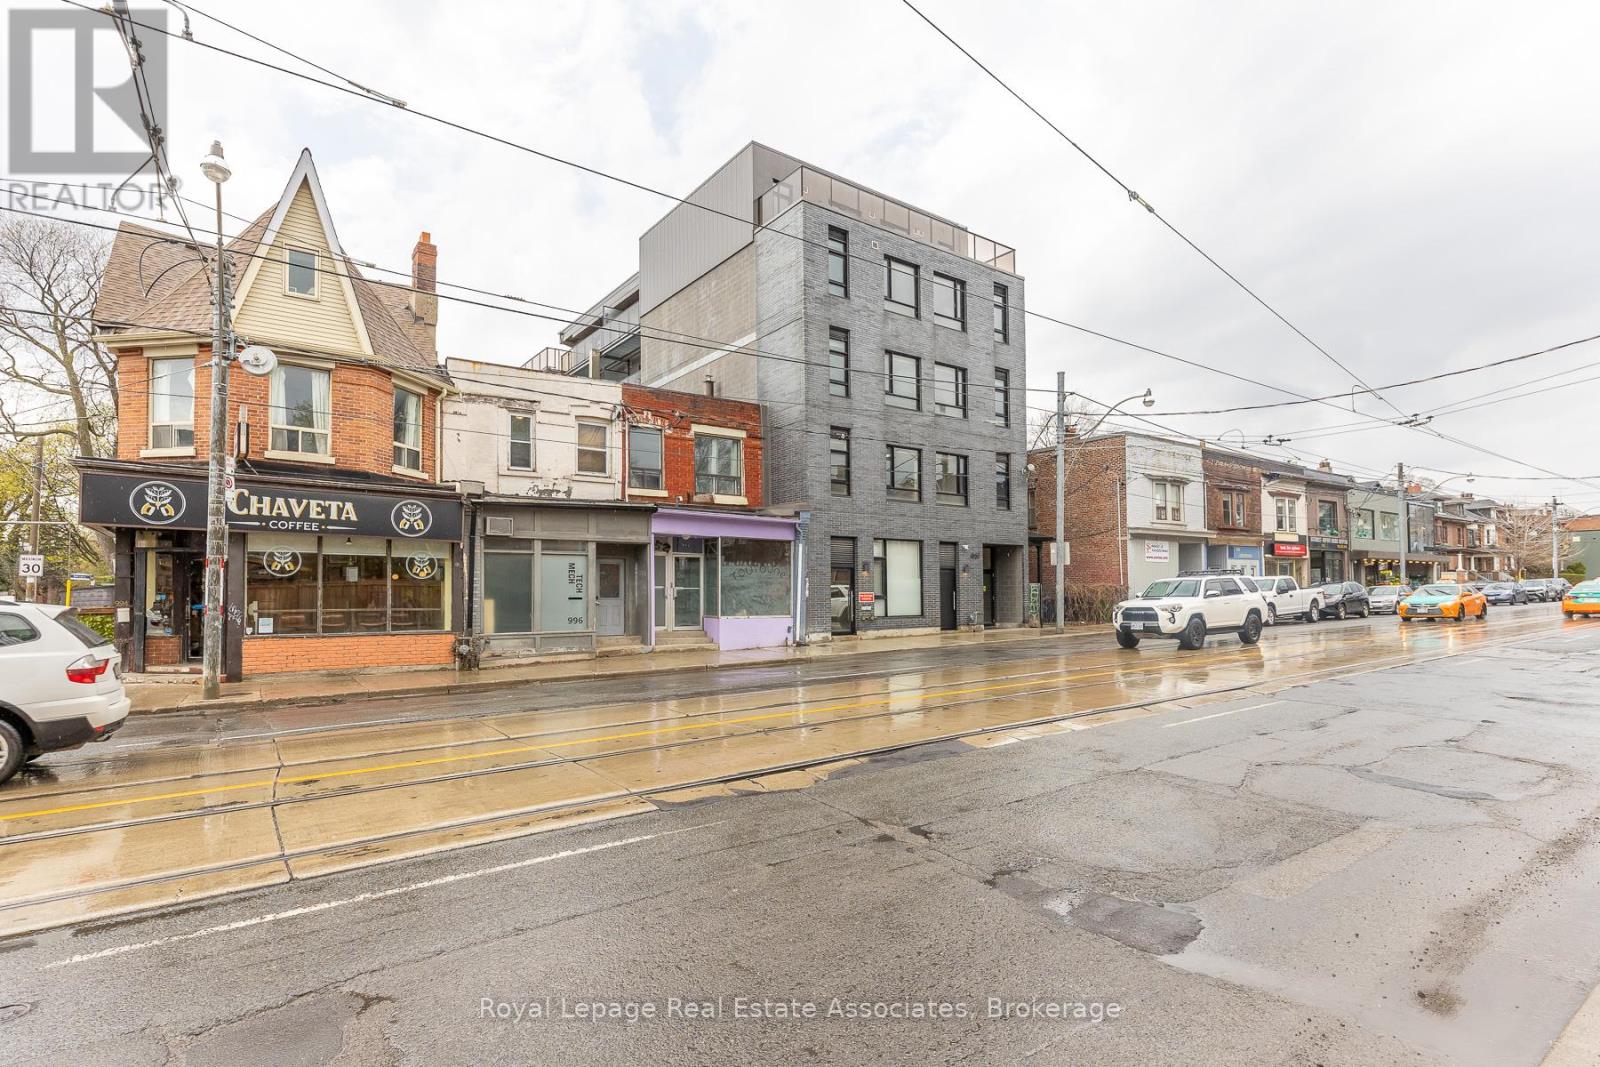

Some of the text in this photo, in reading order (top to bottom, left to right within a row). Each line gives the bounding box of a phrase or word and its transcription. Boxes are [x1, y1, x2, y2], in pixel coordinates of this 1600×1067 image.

[226, 488, 359, 522] CHAVETA
[269, 520, 320, 531] COFFEE
[22, 563, 41, 574] 30
[567, 562, 576, 584] MECH
[575, 574, 583, 594] TECH
[568, 616, 584, 624] 996
